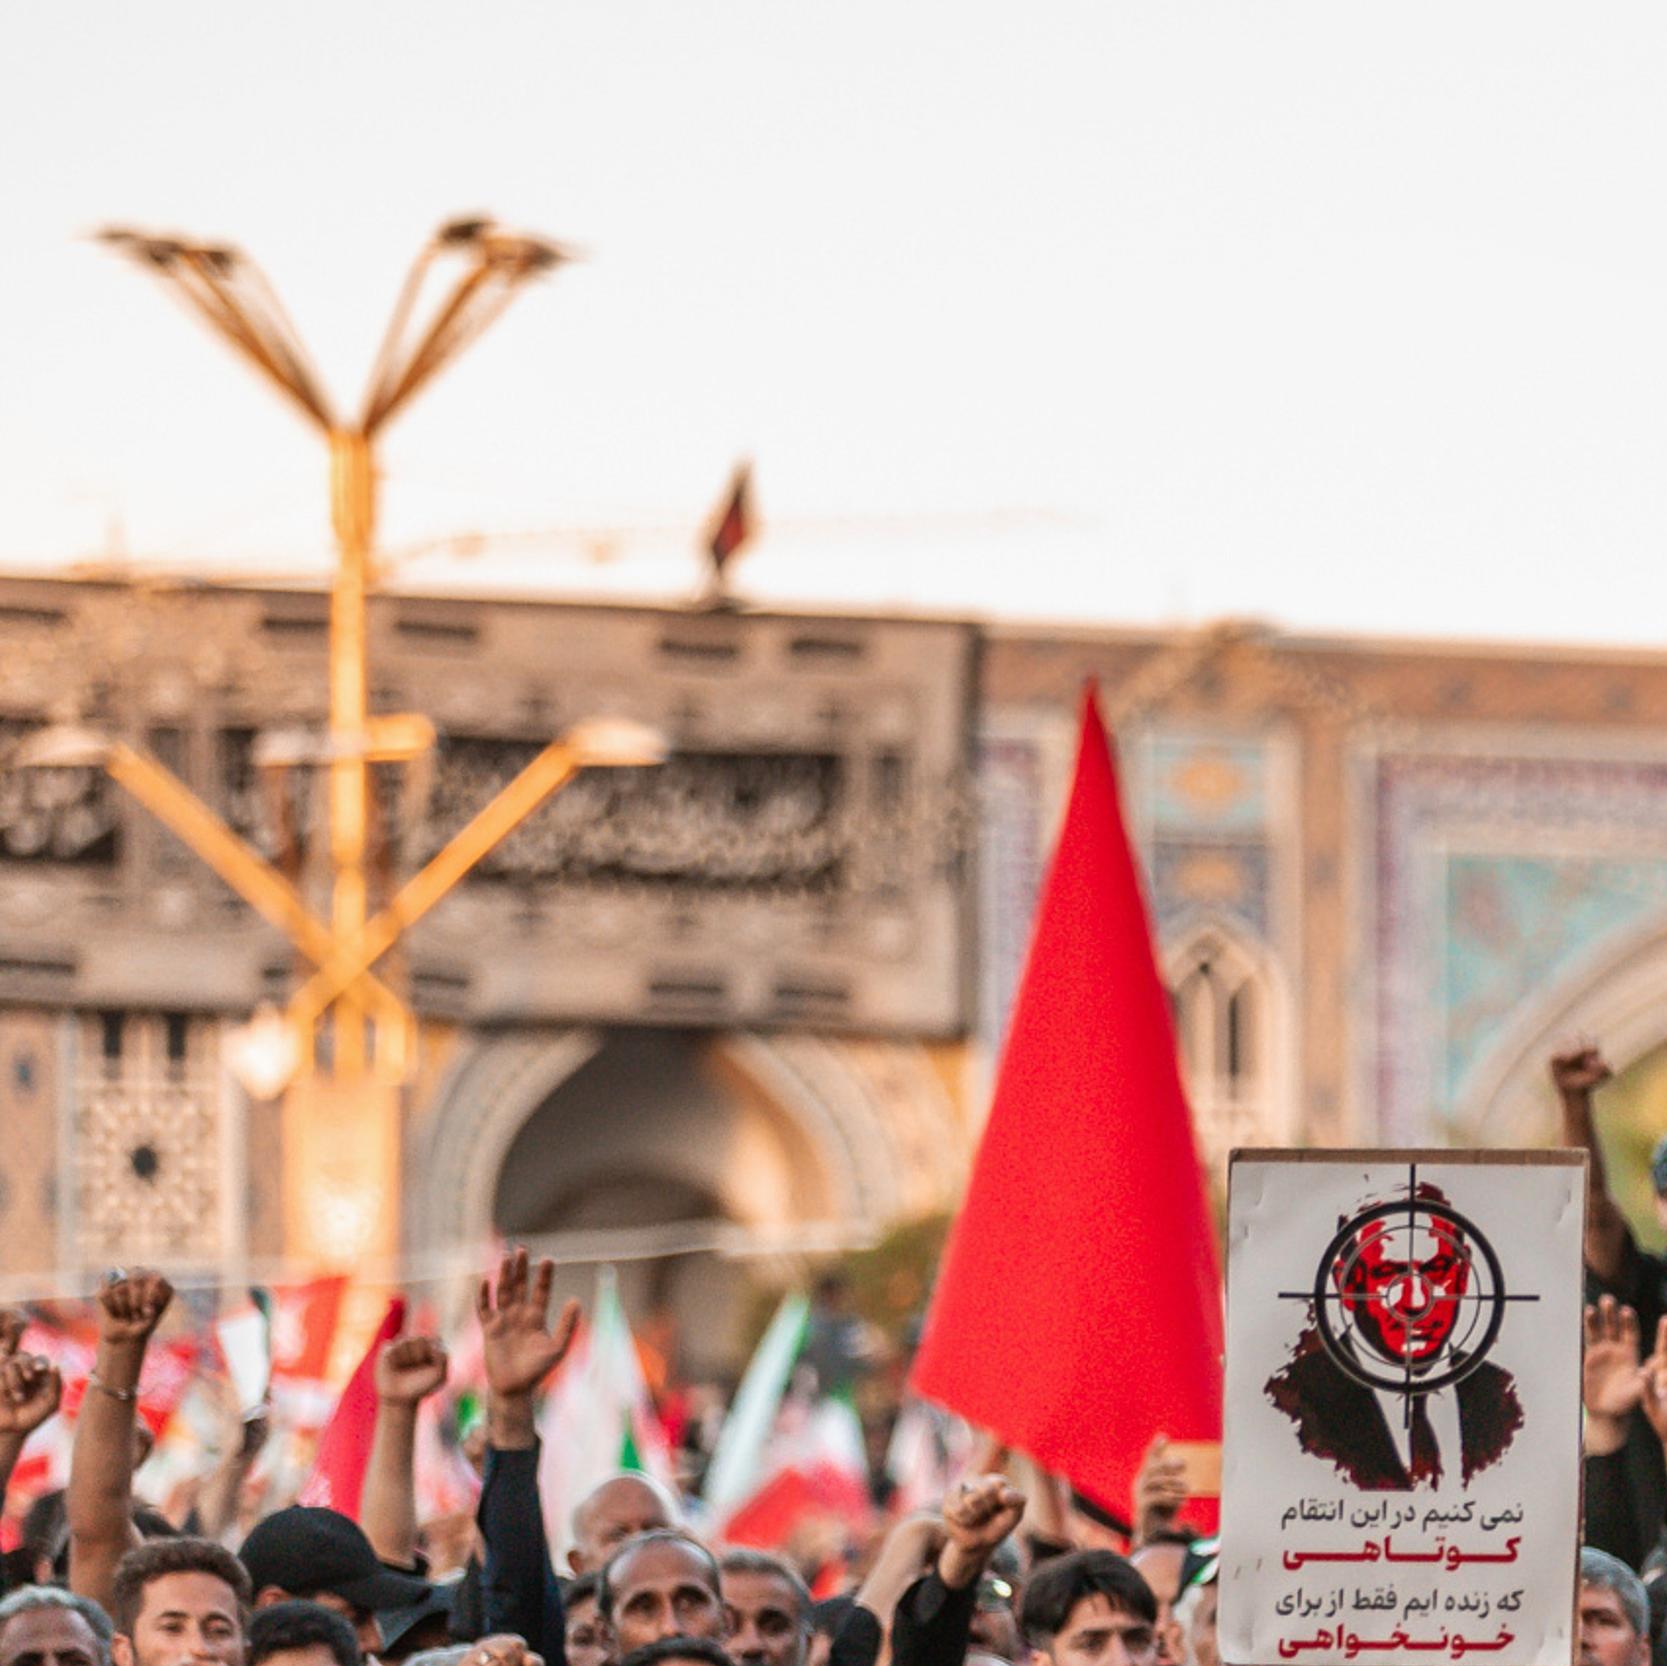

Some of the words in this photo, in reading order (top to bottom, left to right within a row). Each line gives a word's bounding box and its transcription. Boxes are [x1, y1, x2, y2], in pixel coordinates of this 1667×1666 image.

[1281, 1498, 1344, 1529] انتقام
[1352, 1584, 1398, 1612] فقط
[1497, 1589, 1524, 1612] که
